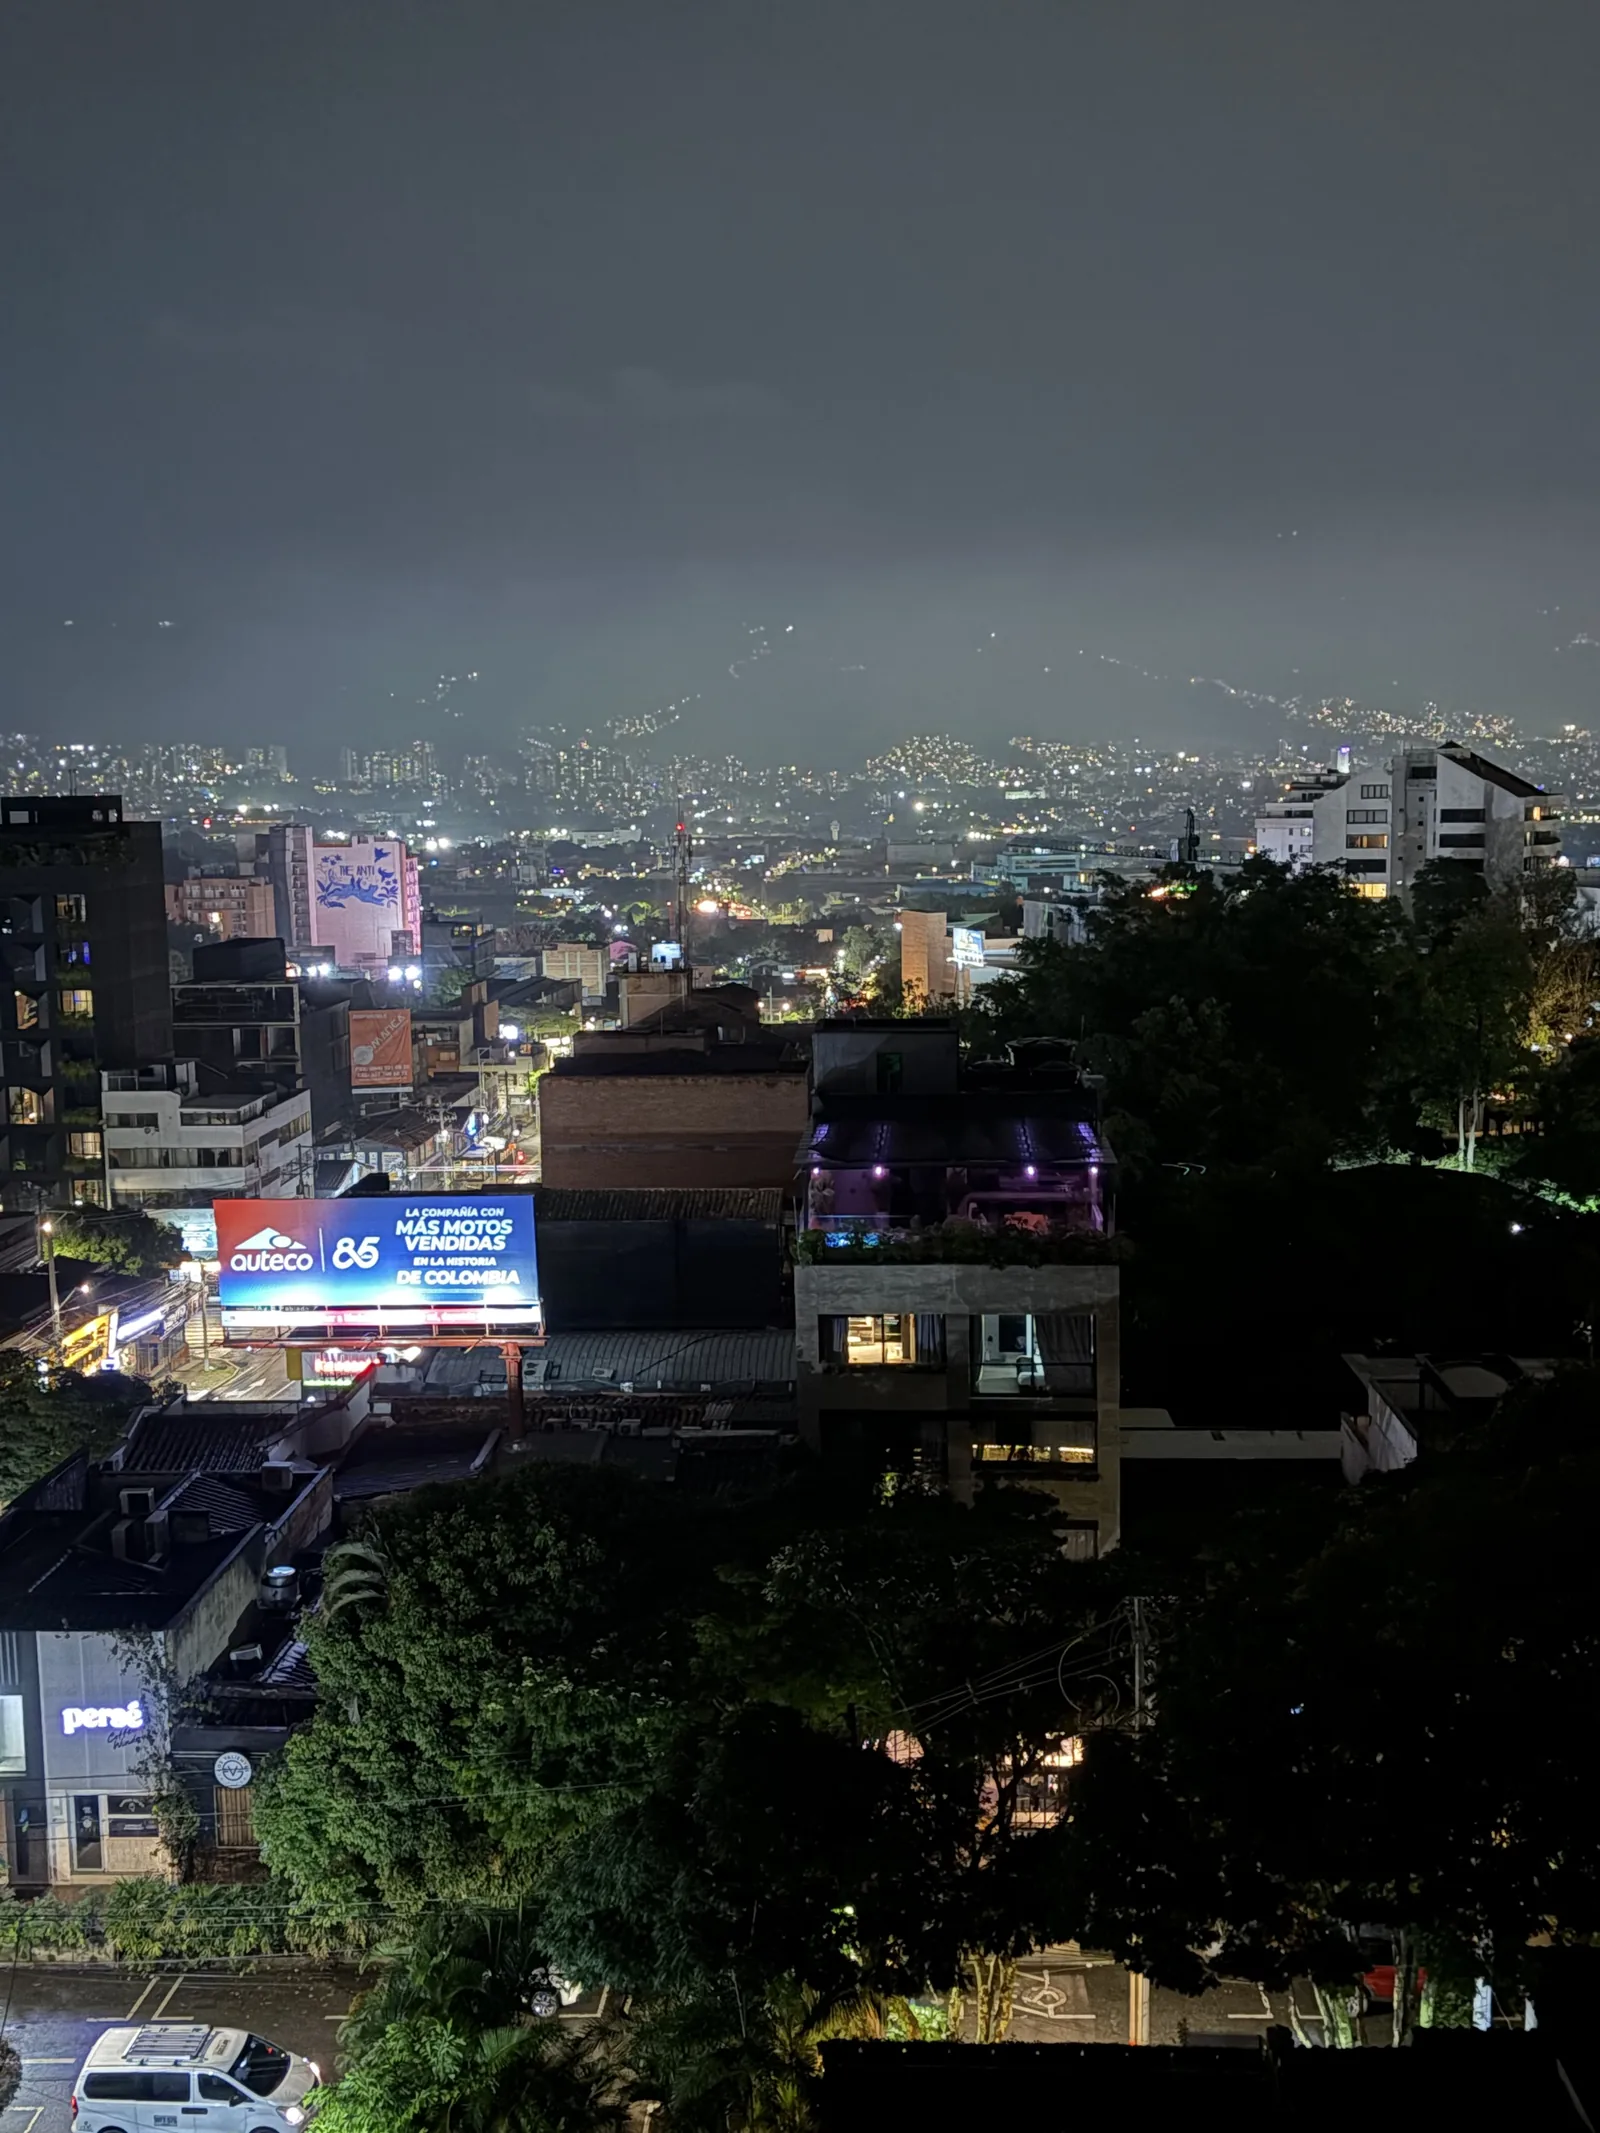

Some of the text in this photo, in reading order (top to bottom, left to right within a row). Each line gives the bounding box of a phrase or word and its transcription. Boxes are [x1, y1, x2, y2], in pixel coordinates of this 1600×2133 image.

[339, 865, 375, 876] THE ANTI
[405, 1206, 504, 1217] LA COMPAÑÍA CON
[395, 1216, 513, 1236] MÁS MOTOS
[404, 1235, 506, 1252] VENDIDAS
[230, 1250, 314, 1272] auteco
[332, 1236, 380, 1270] 85
[413, 1257, 497, 1266] EN LA HISTORIA
[396, 1270, 520, 1285] DE COLOMBIA
